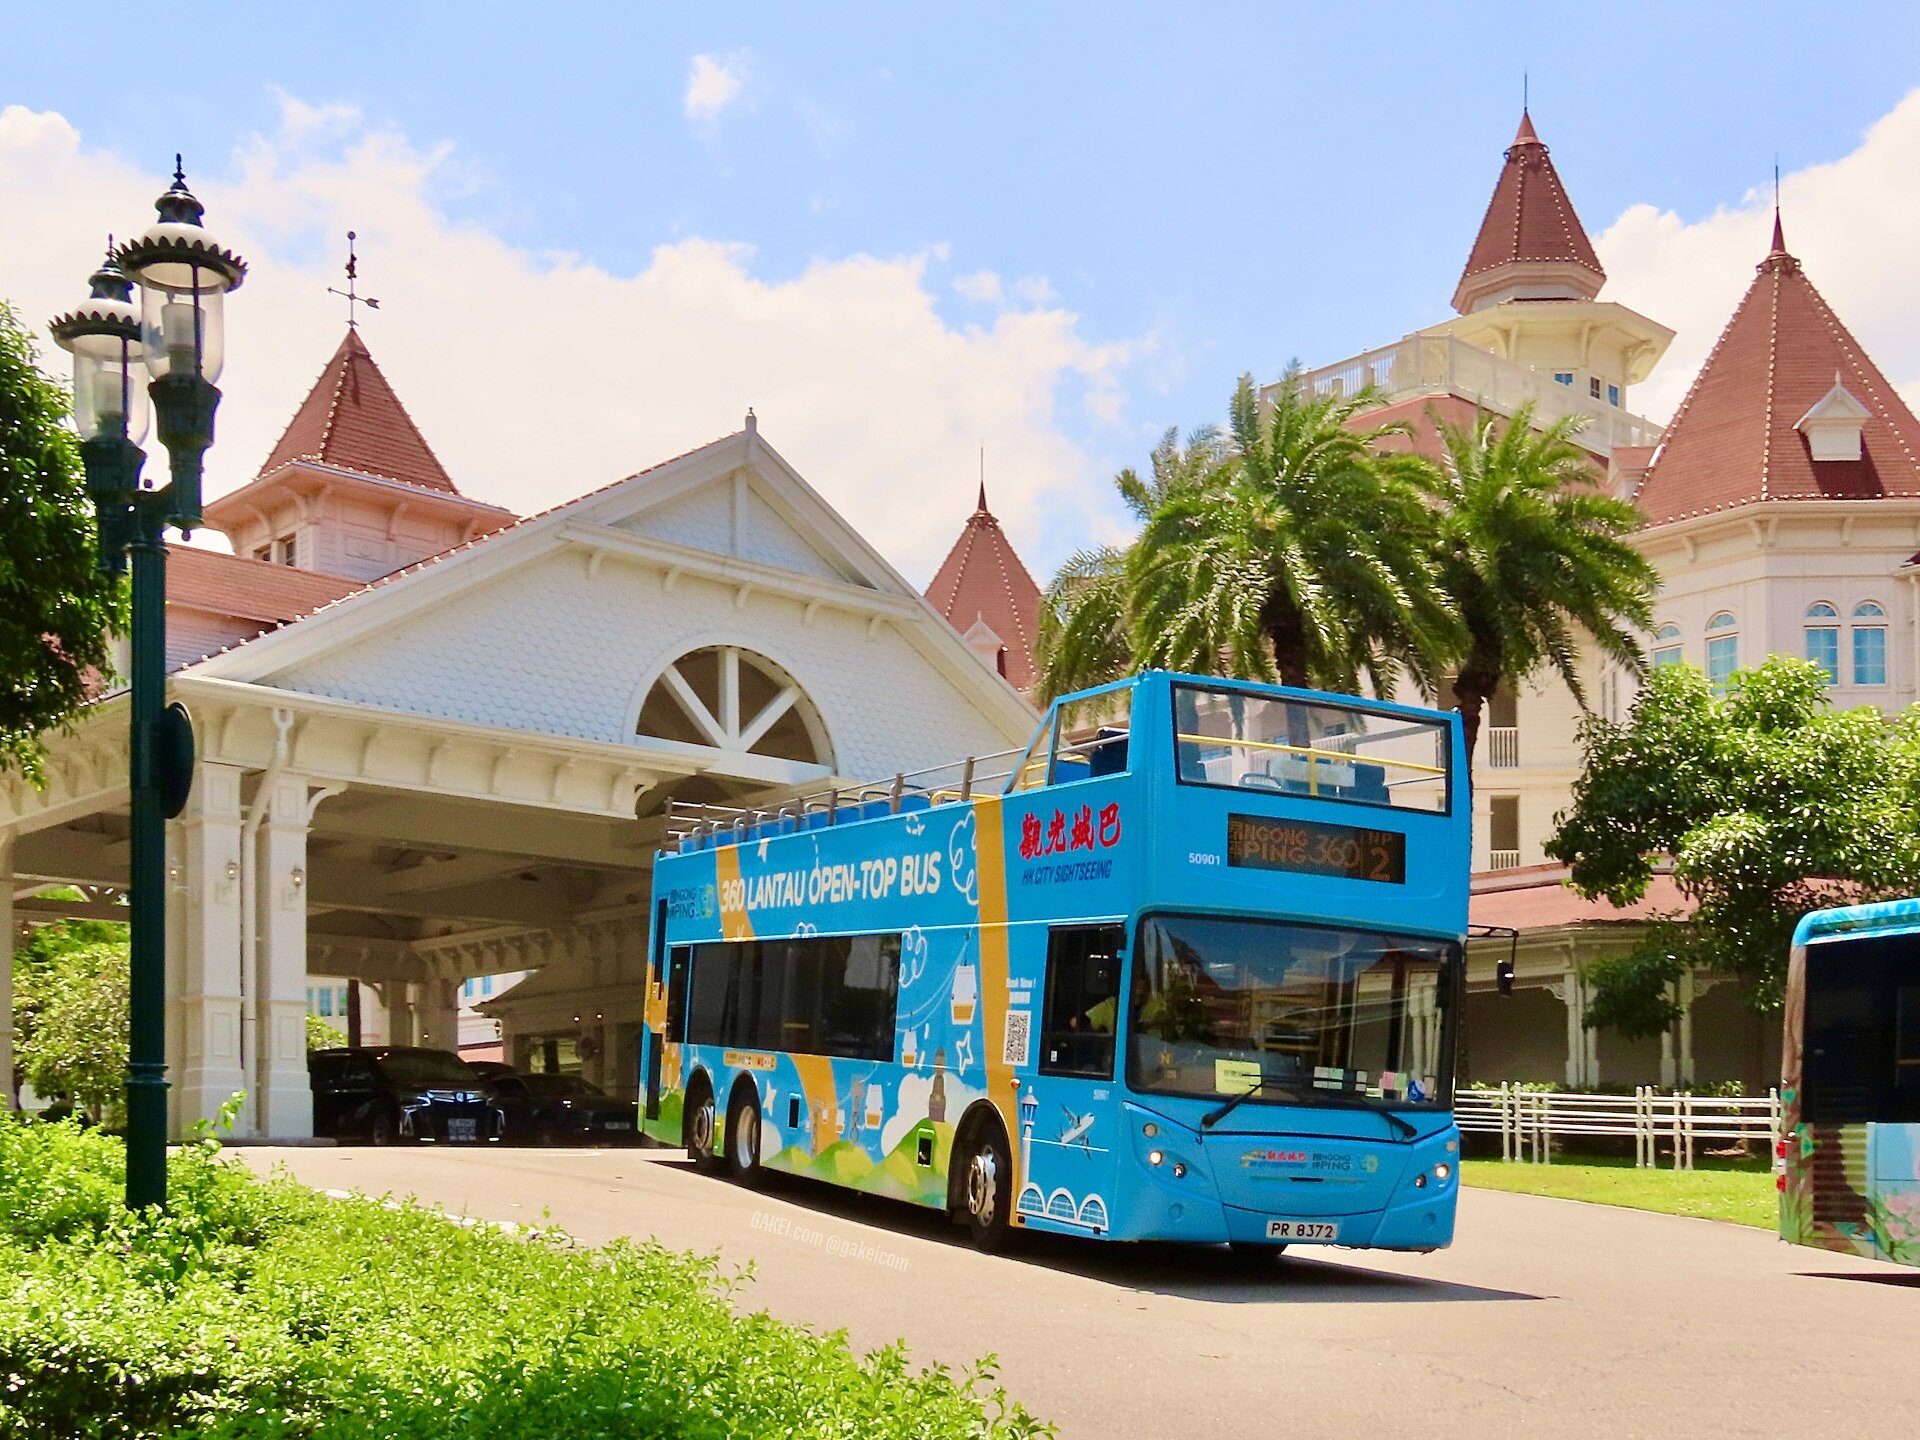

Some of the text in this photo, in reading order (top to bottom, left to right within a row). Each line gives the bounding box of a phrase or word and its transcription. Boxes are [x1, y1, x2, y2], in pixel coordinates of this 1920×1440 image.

[1018, 801, 1121, 860] 觀光城巴
[1188, 852, 1221, 865] 50901
[1244, 841, 1309, 864] PING
[1308, 834, 1360, 868] 360
[1369, 846, 1391, 881] 2
[720, 878, 745, 912] 360
[747, 870, 806, 910] LANTAU
[808, 857, 898, 905] OPEN-TOP
[900, 850, 942, 897] BUS
[1035, 866, 1055, 885] CITY
[1054, 859, 1112, 883] SIGHTSEEING
[1271, 1222, 1334, 1238] PR 8372
